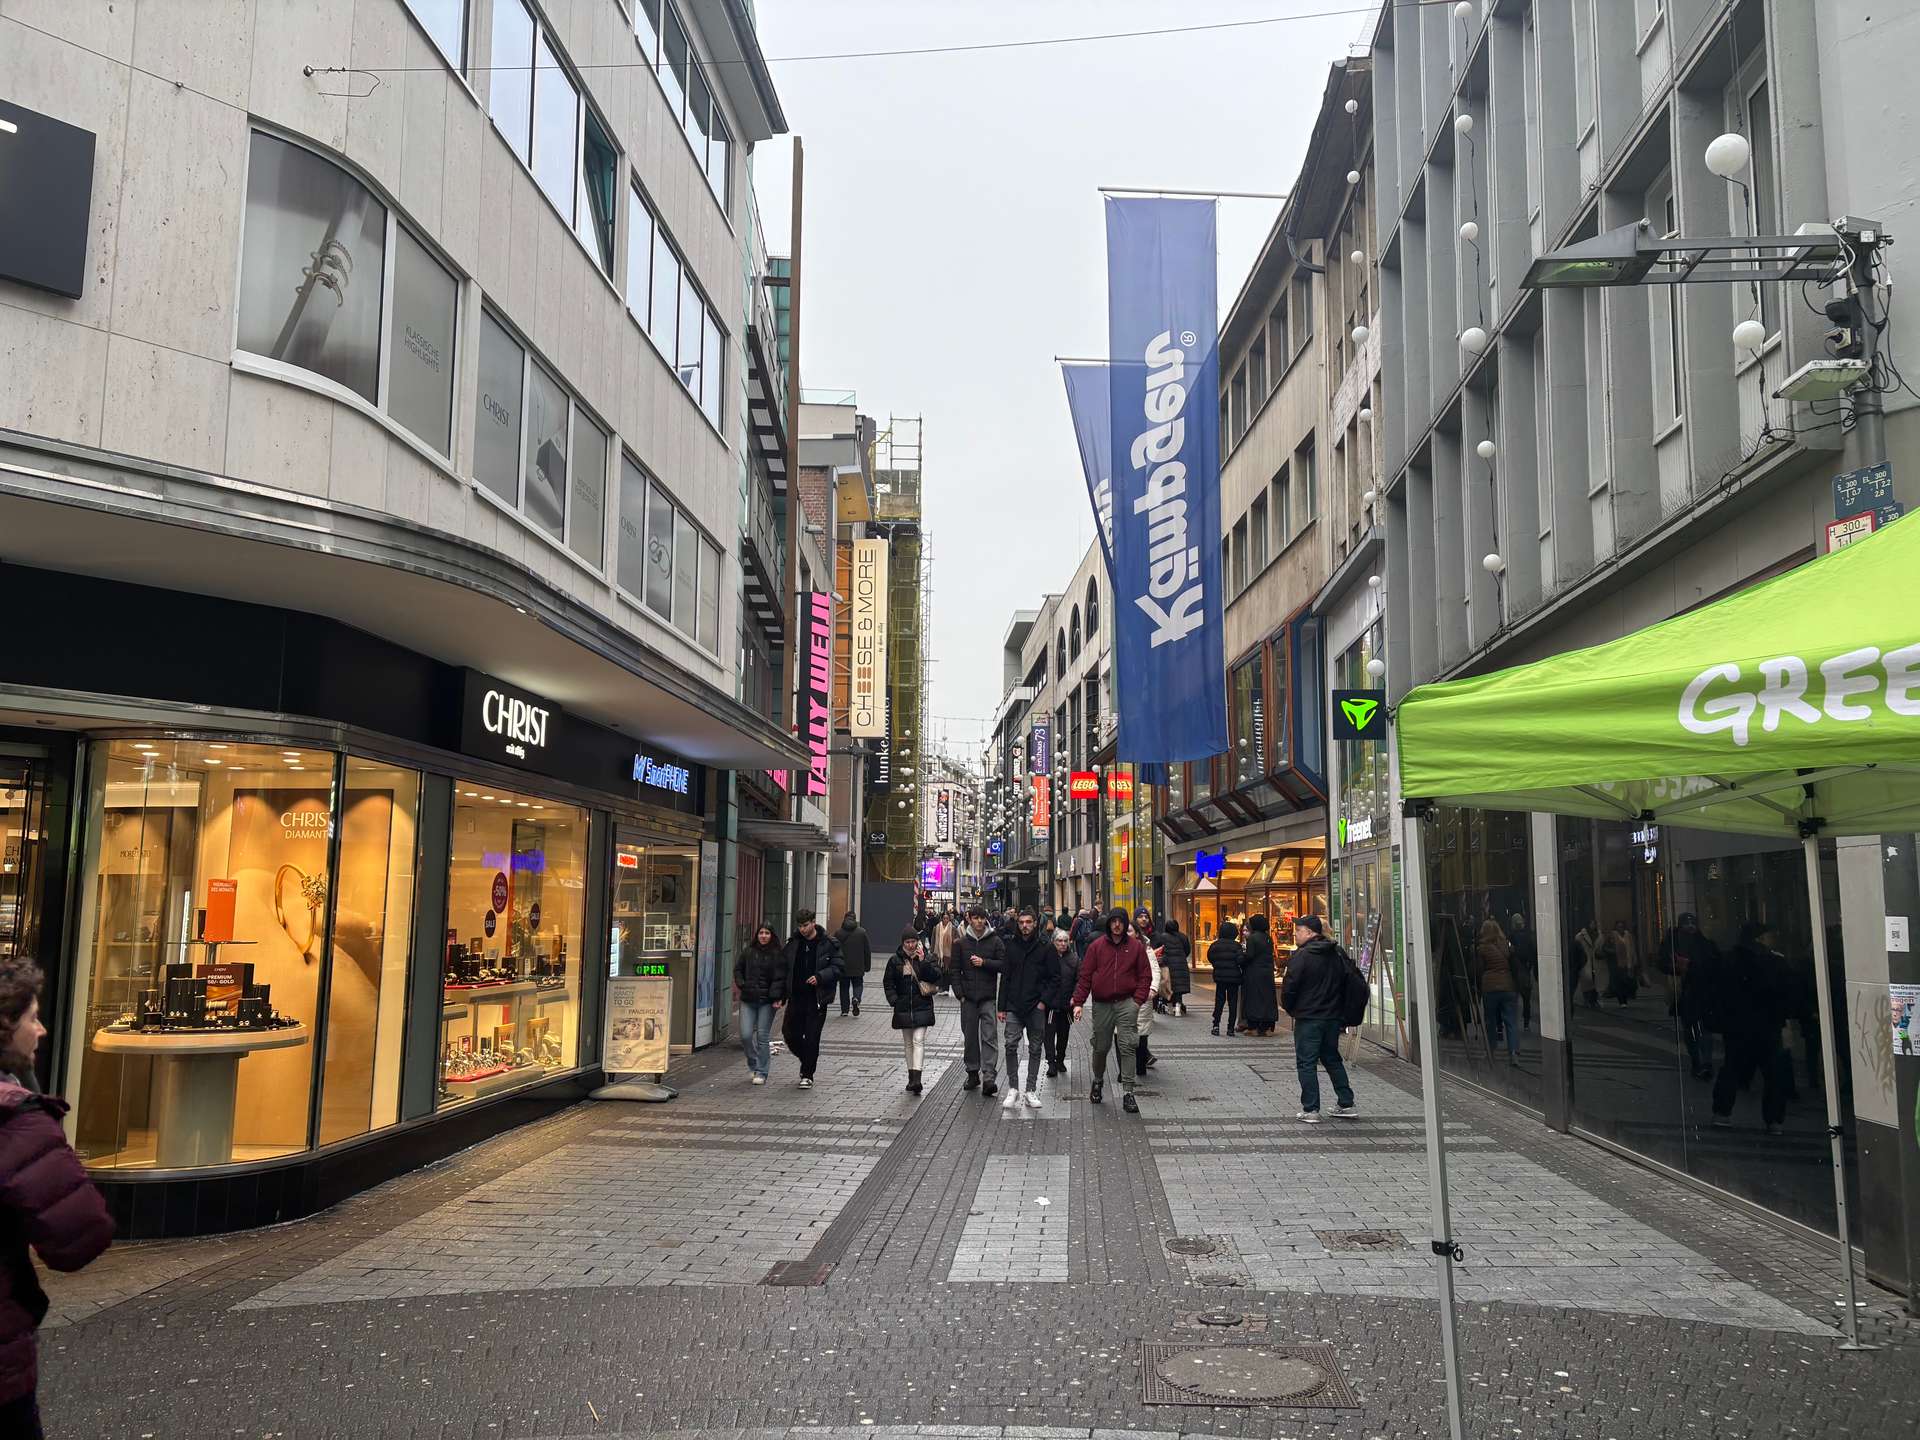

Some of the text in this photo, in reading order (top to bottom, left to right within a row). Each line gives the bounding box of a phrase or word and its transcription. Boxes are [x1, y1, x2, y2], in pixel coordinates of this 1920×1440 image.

[483, 393, 510, 428] CHRIST
[1875, 471, 1887, 480] 300
[1846, 480, 1858, 488] 300
[1829, 527, 1836, 537] H
[1843, 519, 1861, 533] 300
[858, 549, 874, 613] MORE
[857, 617, 873, 631] &
[482, 690, 550, 748] CHRIST
[1034, 728, 1046, 741] 73
[807, 696, 828, 796] TALLY
[1071, 778, 1097, 791] LEGO
[1347, 815, 1373, 844] freenet
[931, 891, 954, 900] SATURN
[485, 920, 496, 928] SALE
[635, 964, 666, 976] OPEN
